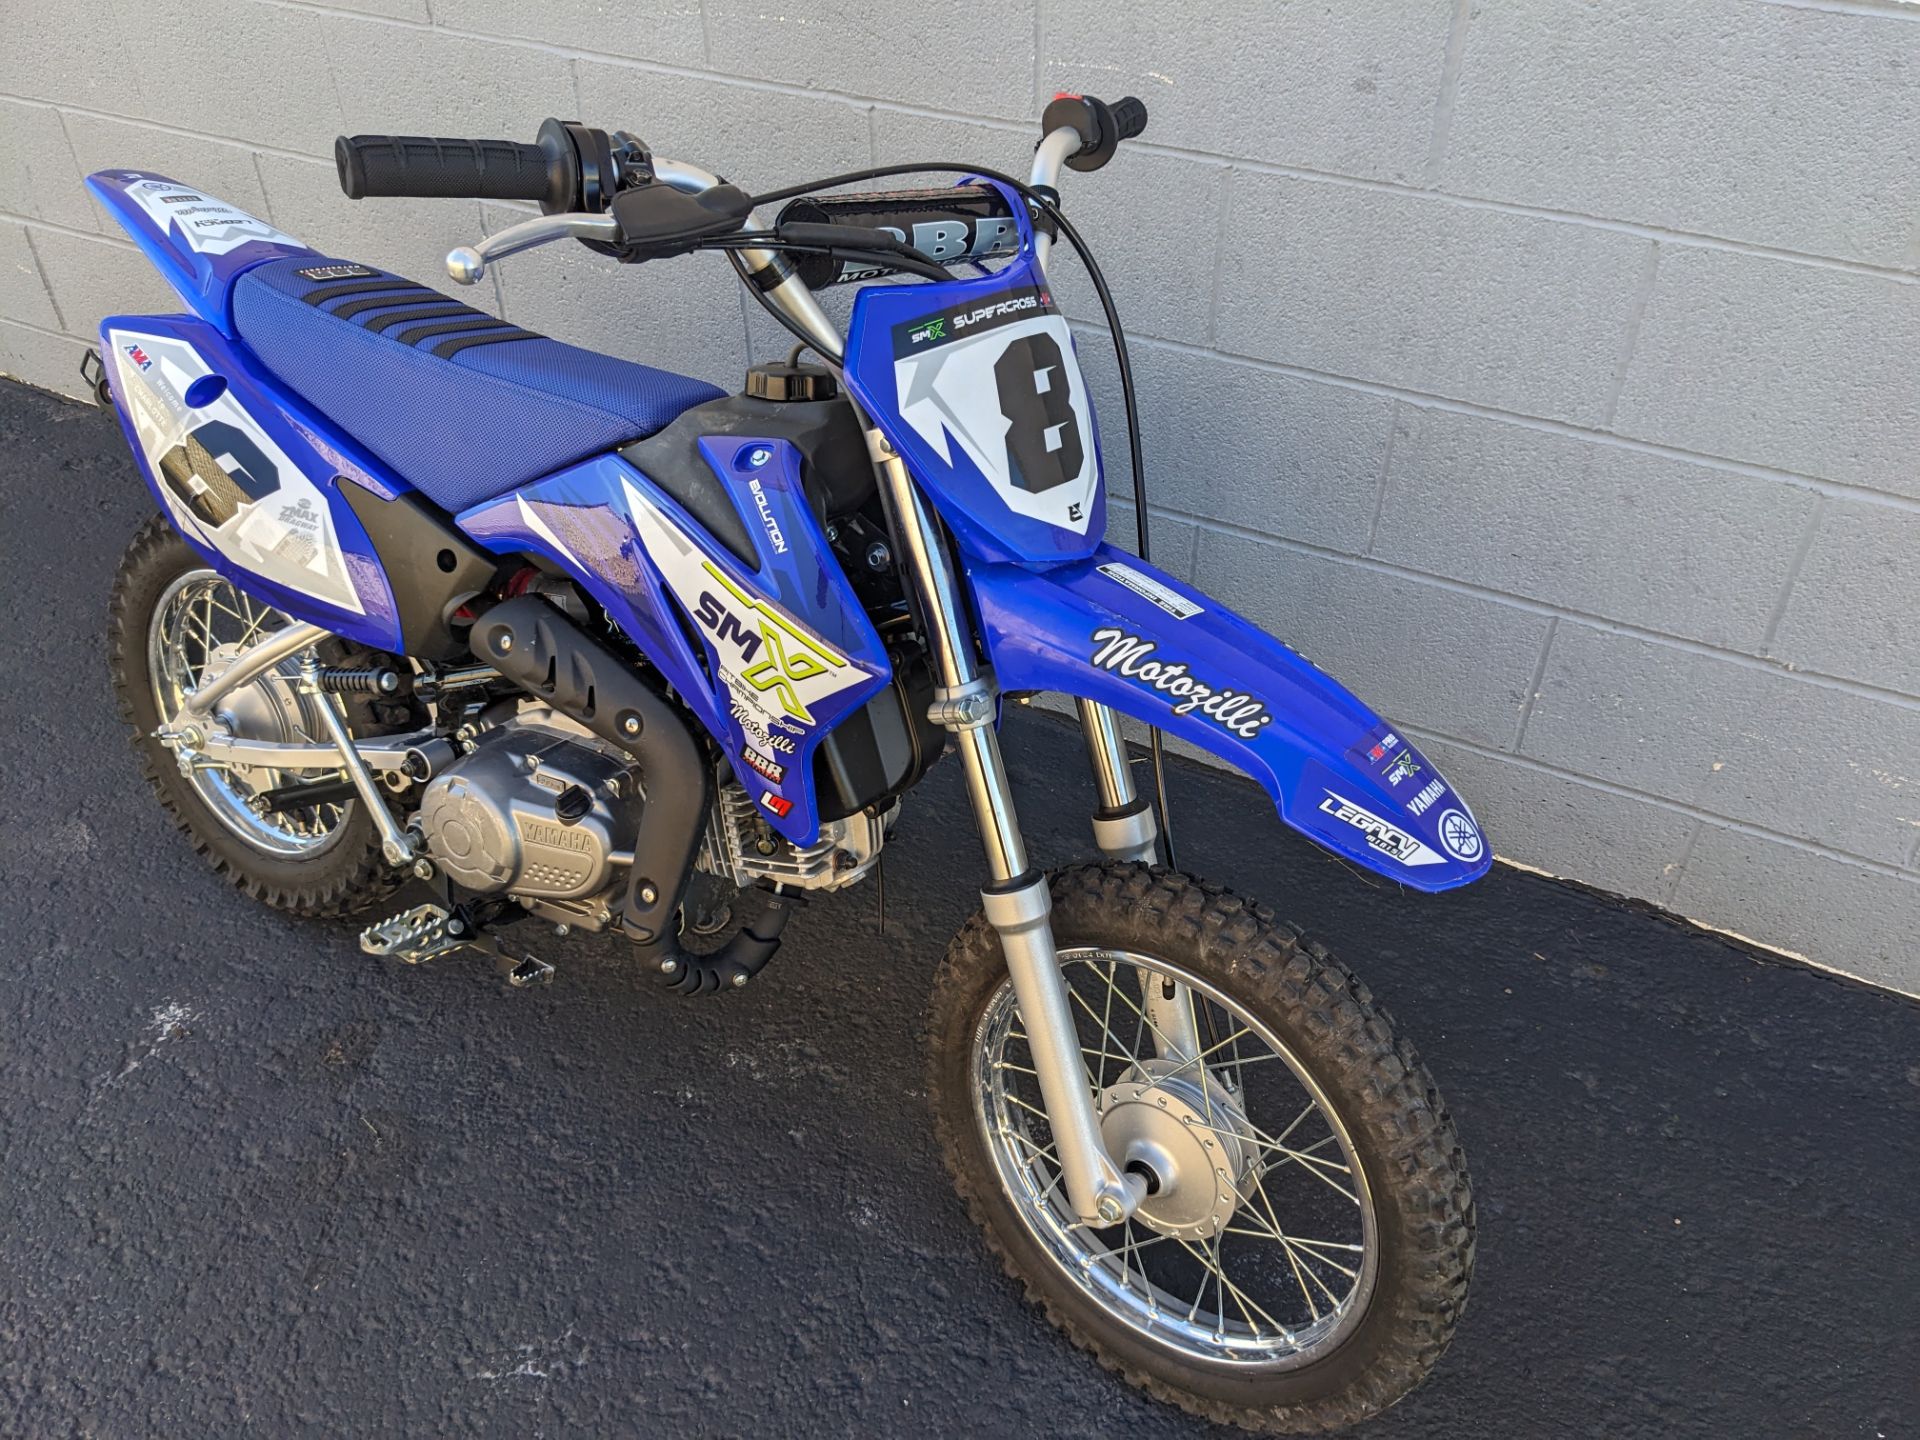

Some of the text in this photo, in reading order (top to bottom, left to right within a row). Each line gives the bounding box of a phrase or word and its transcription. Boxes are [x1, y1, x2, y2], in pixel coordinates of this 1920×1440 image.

[911, 323, 947, 344] SMX
[953, 296, 1036, 329] SUPERCROSS
[123, 343, 153, 373] AMA
[994, 332, 1084, 494] 8
[749, 478, 788, 554] EVOLUTION
[698, 590, 828, 725] SMX
[1093, 628, 1272, 738] Motozilli
[730, 699, 796, 754] Motozilli
[744, 747, 783, 778] BBR
[1388, 752, 1421, 787] SMX
[1406, 778, 1446, 816] YAMAHA
[524, 821, 592, 852] YAMAHA
[1318, 797, 1421, 861] LEGACY
